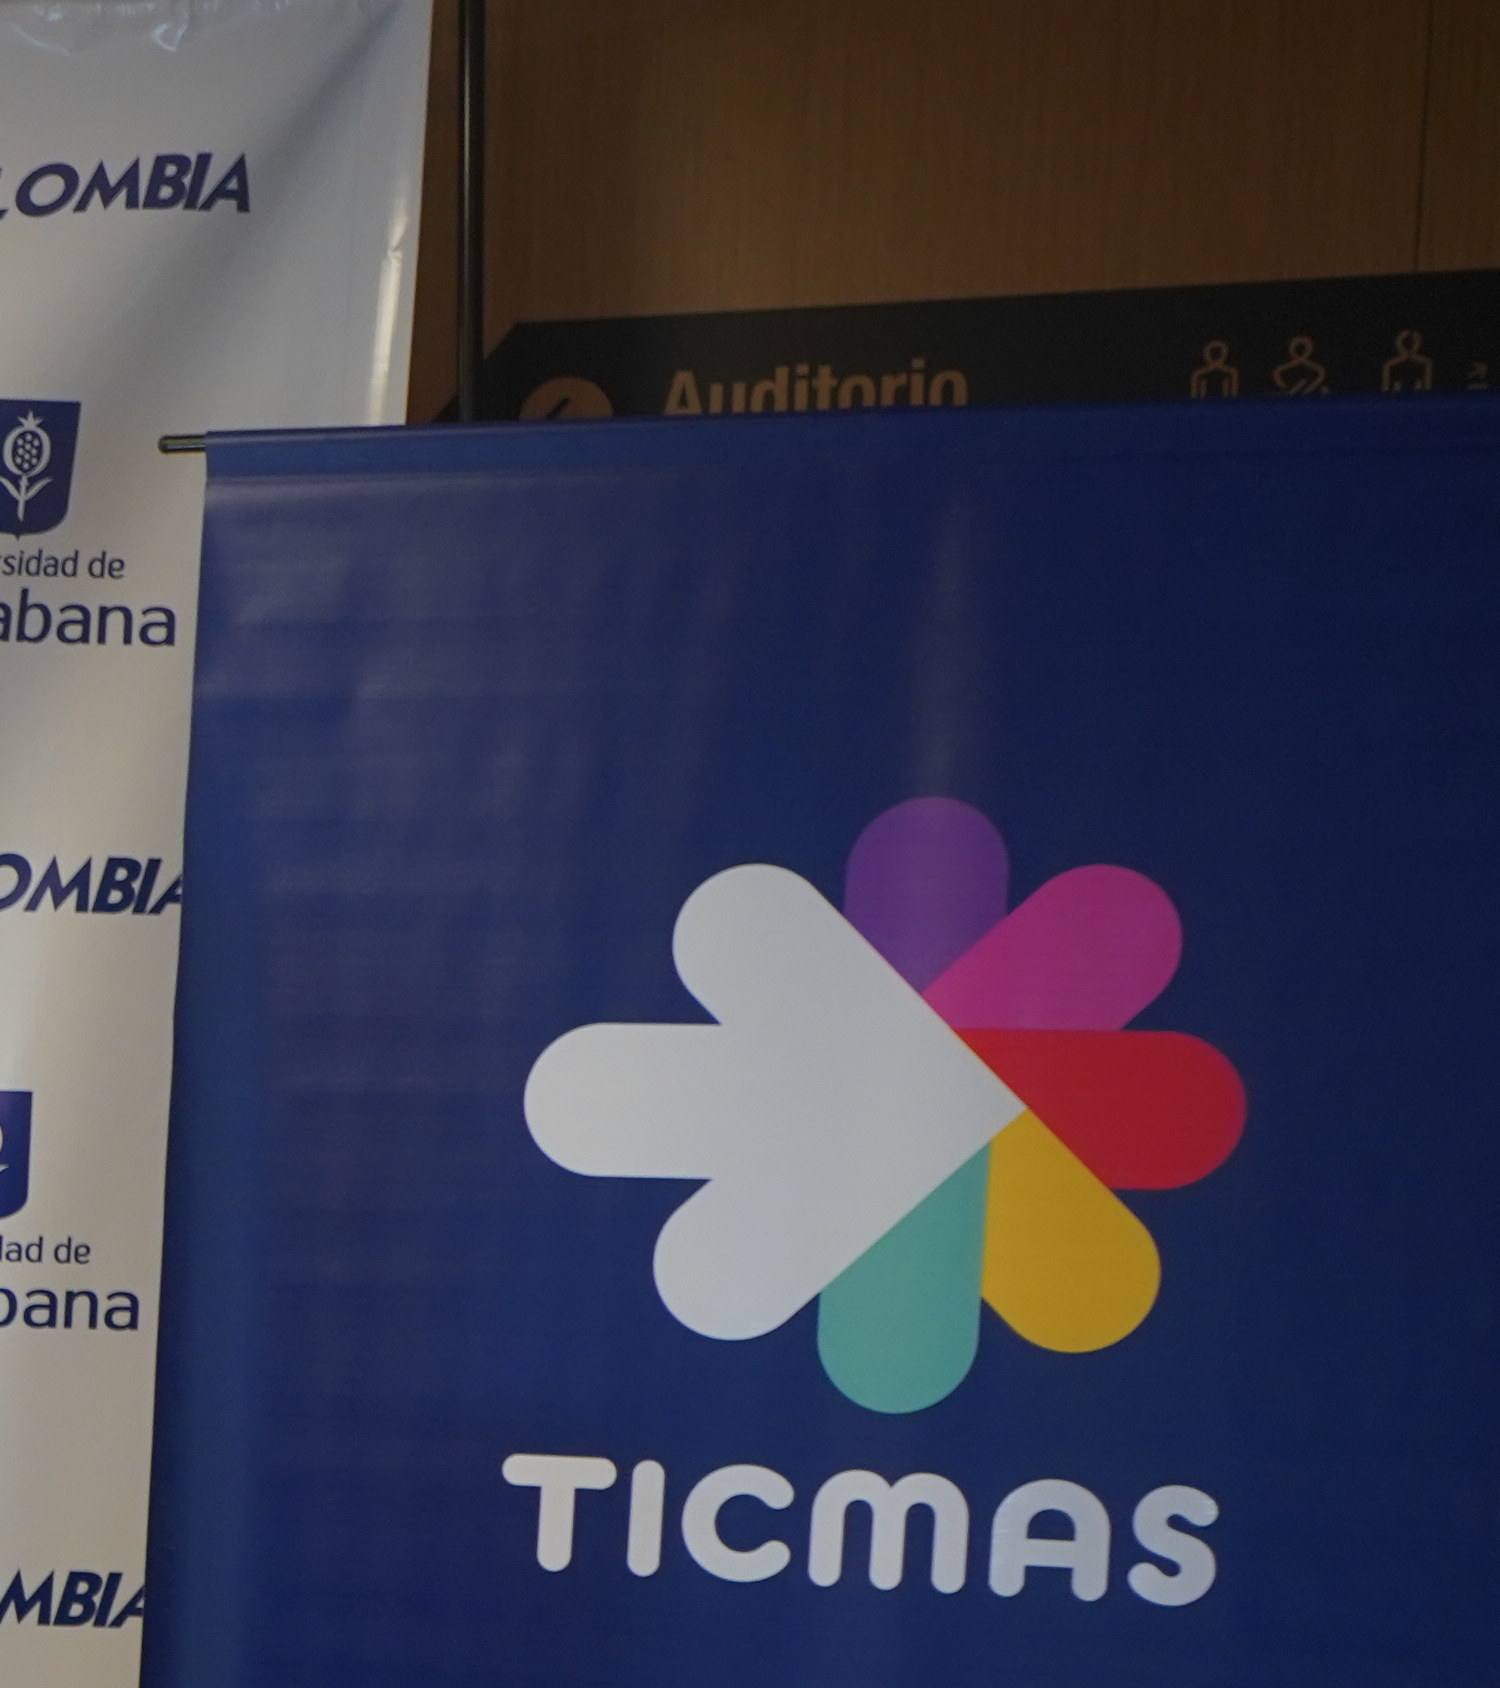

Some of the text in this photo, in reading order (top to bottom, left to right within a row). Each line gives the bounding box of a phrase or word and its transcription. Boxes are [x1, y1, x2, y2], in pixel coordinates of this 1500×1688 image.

[660, 354, 970, 417] Auditorio
[87, 549, 126, 580] de
[53, 1235, 91, 1265] de
[501, 1453, 1219, 1607] TICMAS
